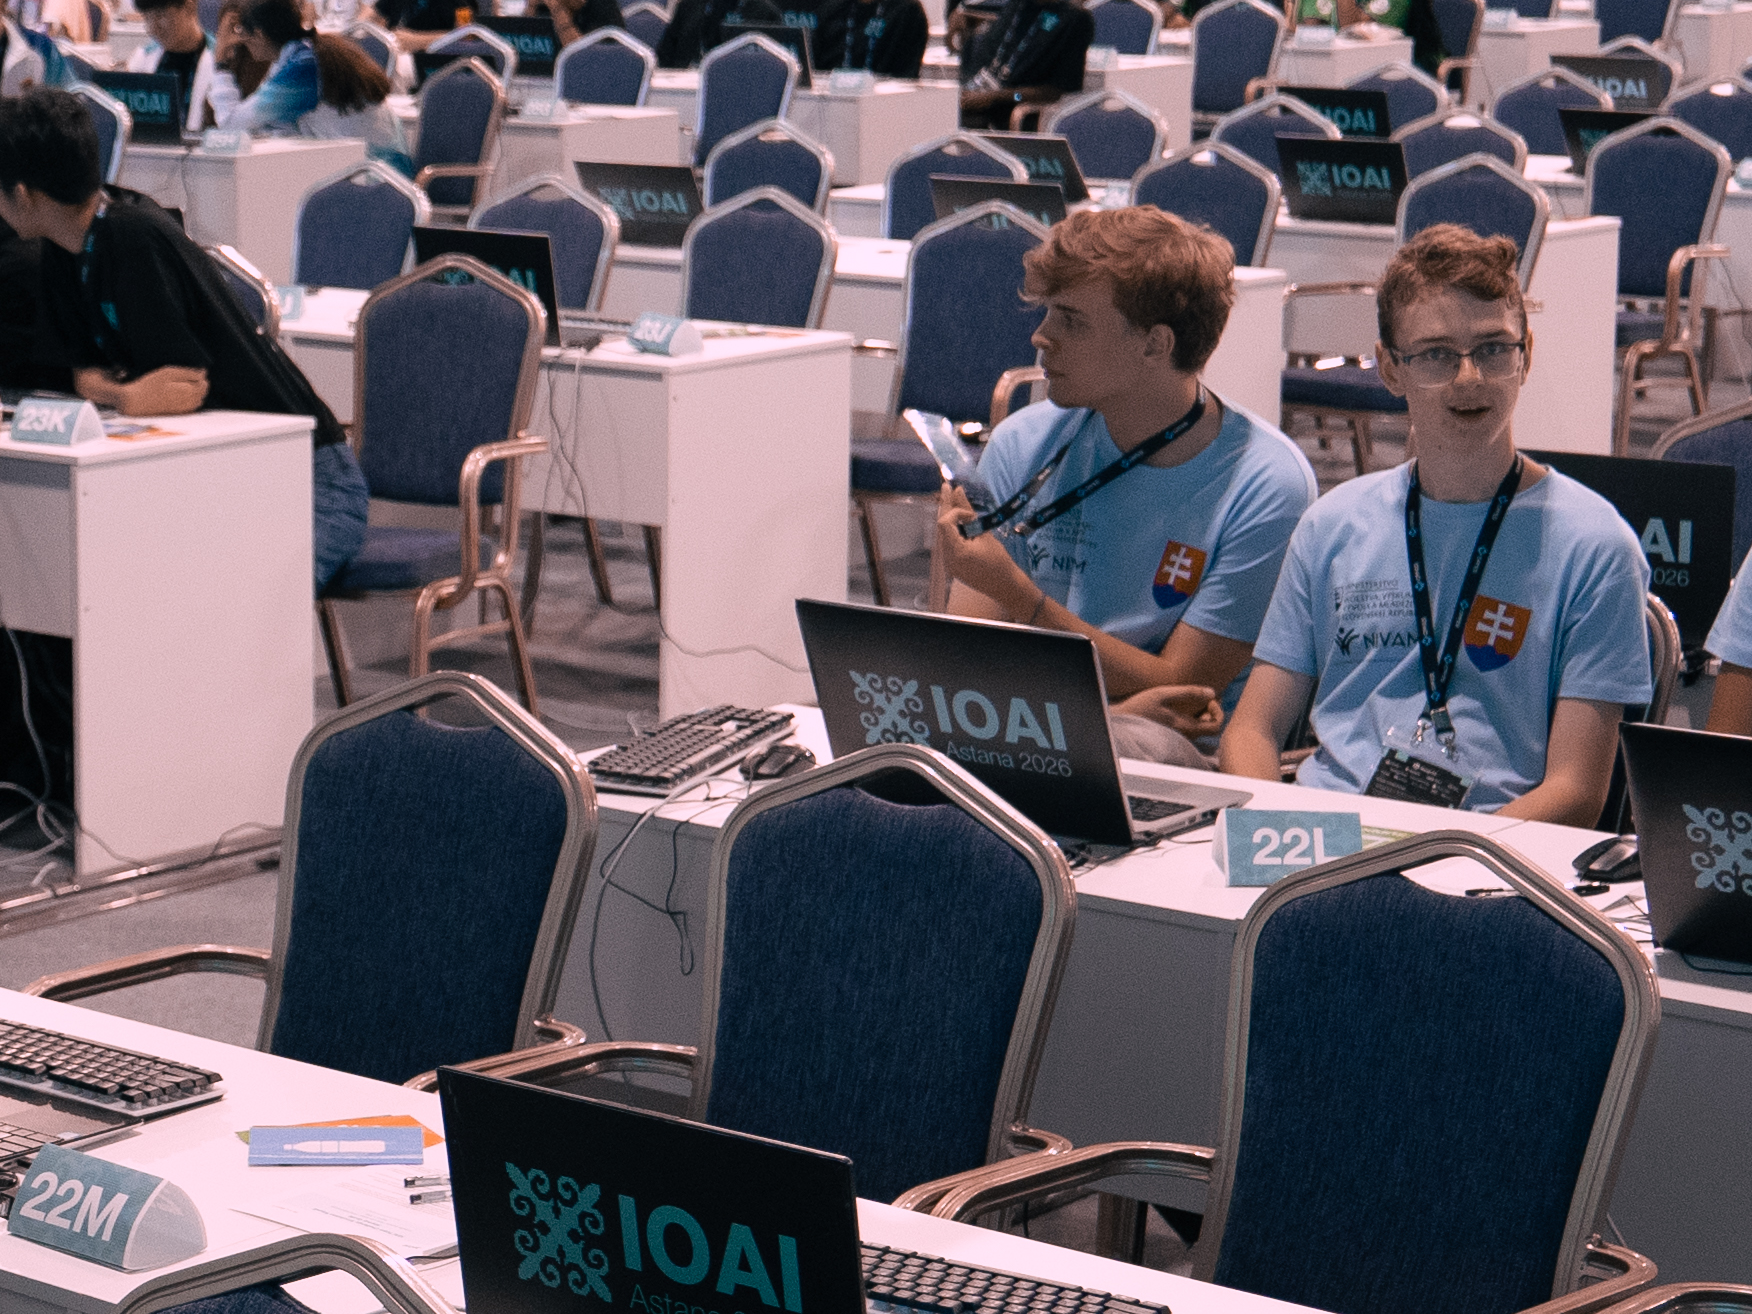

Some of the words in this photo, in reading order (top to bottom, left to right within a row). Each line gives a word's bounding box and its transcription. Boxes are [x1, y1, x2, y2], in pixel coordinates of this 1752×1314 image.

[784, 11, 818, 29] OAI
[128, 91, 171, 114] IOAI
[1024, 156, 1065, 177] OAI
[1332, 164, 1392, 190] IOAI
[632, 191, 689, 214] IOAI
[1640, 517, 1693, 564] AI
[1652, 567, 1690, 587] 026
[930, 684, 1067, 752] IOAI
[946, 740, 1014, 769] Astana
[1019, 753, 1072, 778] 2026
[1252, 827, 1352, 866] 22L
[18, 1171, 130, 1245] 22M
[618, 1193, 803, 1314] IOAI
